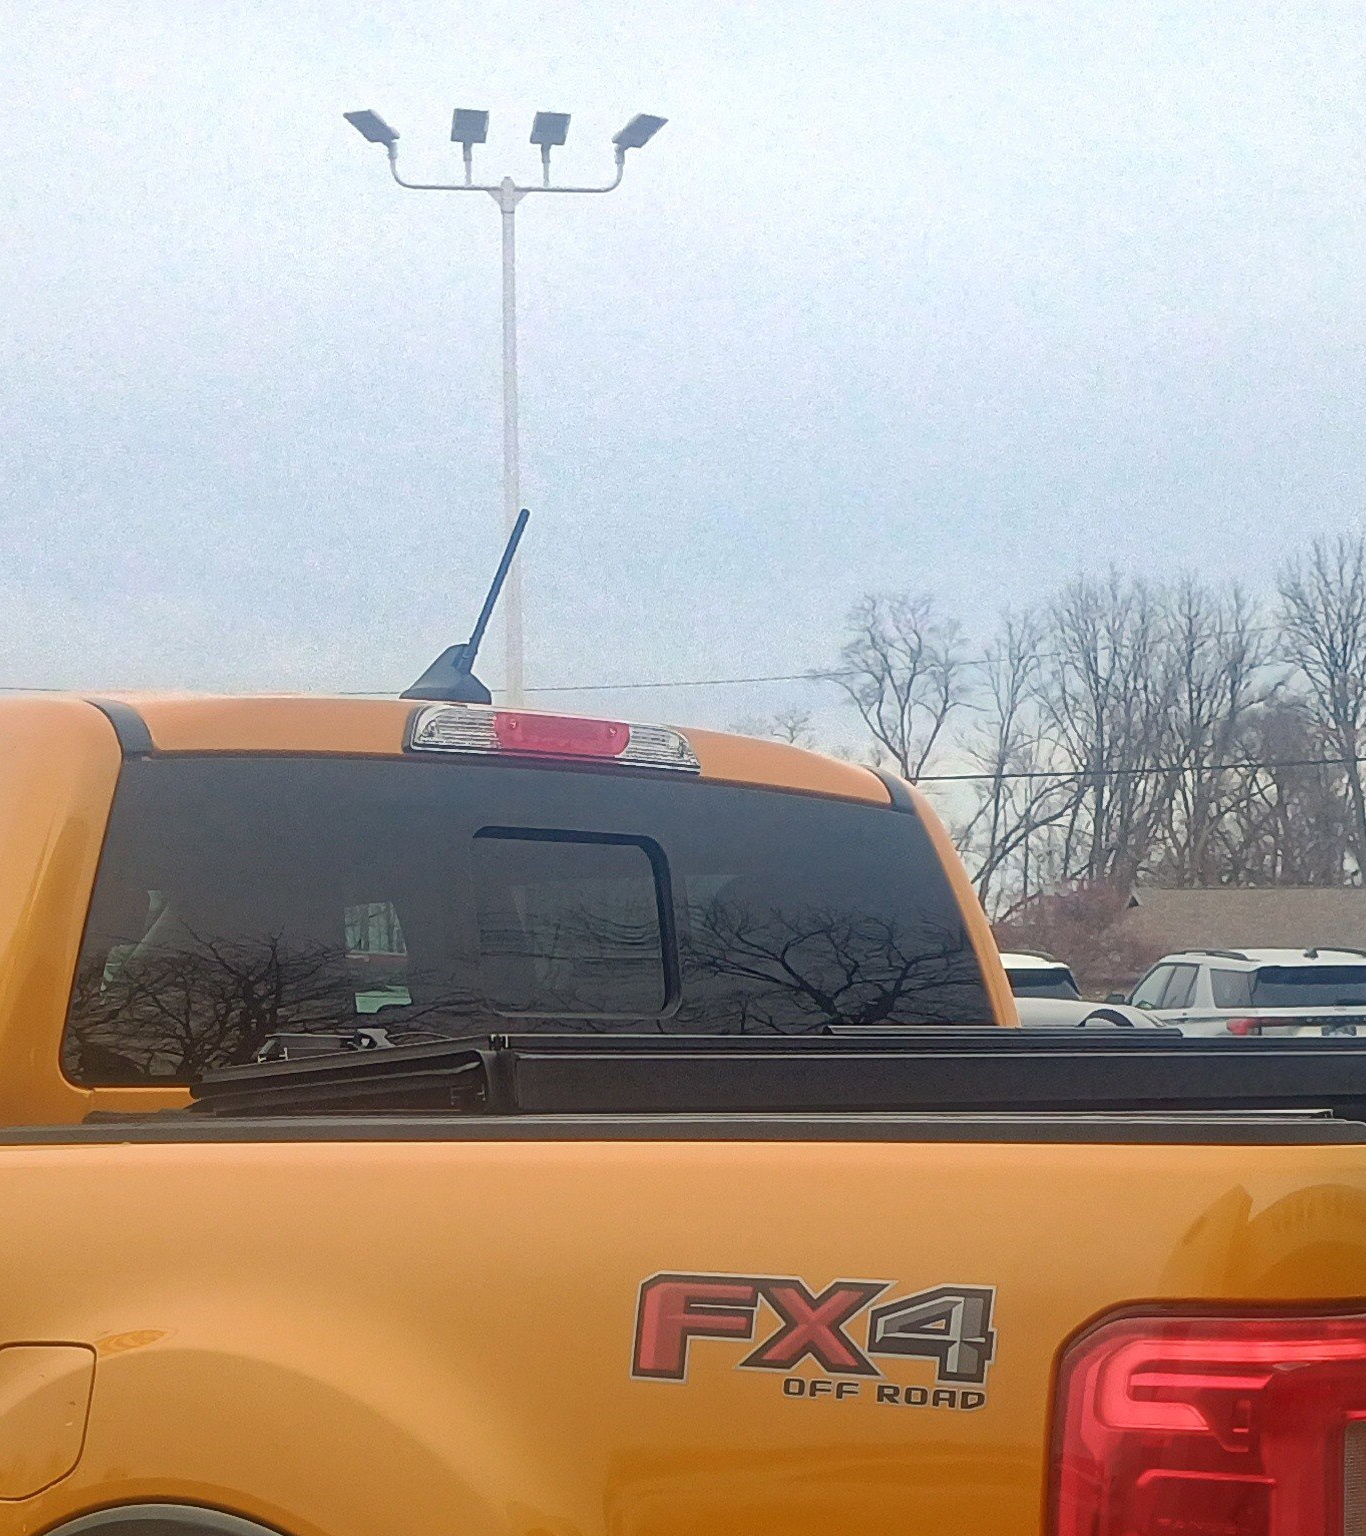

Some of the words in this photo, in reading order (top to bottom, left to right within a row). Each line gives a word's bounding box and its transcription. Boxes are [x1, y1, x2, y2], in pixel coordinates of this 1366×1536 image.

[630, 1270, 998, 1385] FX4
[781, 1377, 861, 1400] OFF
[875, 1384, 987, 1412] ROAD
